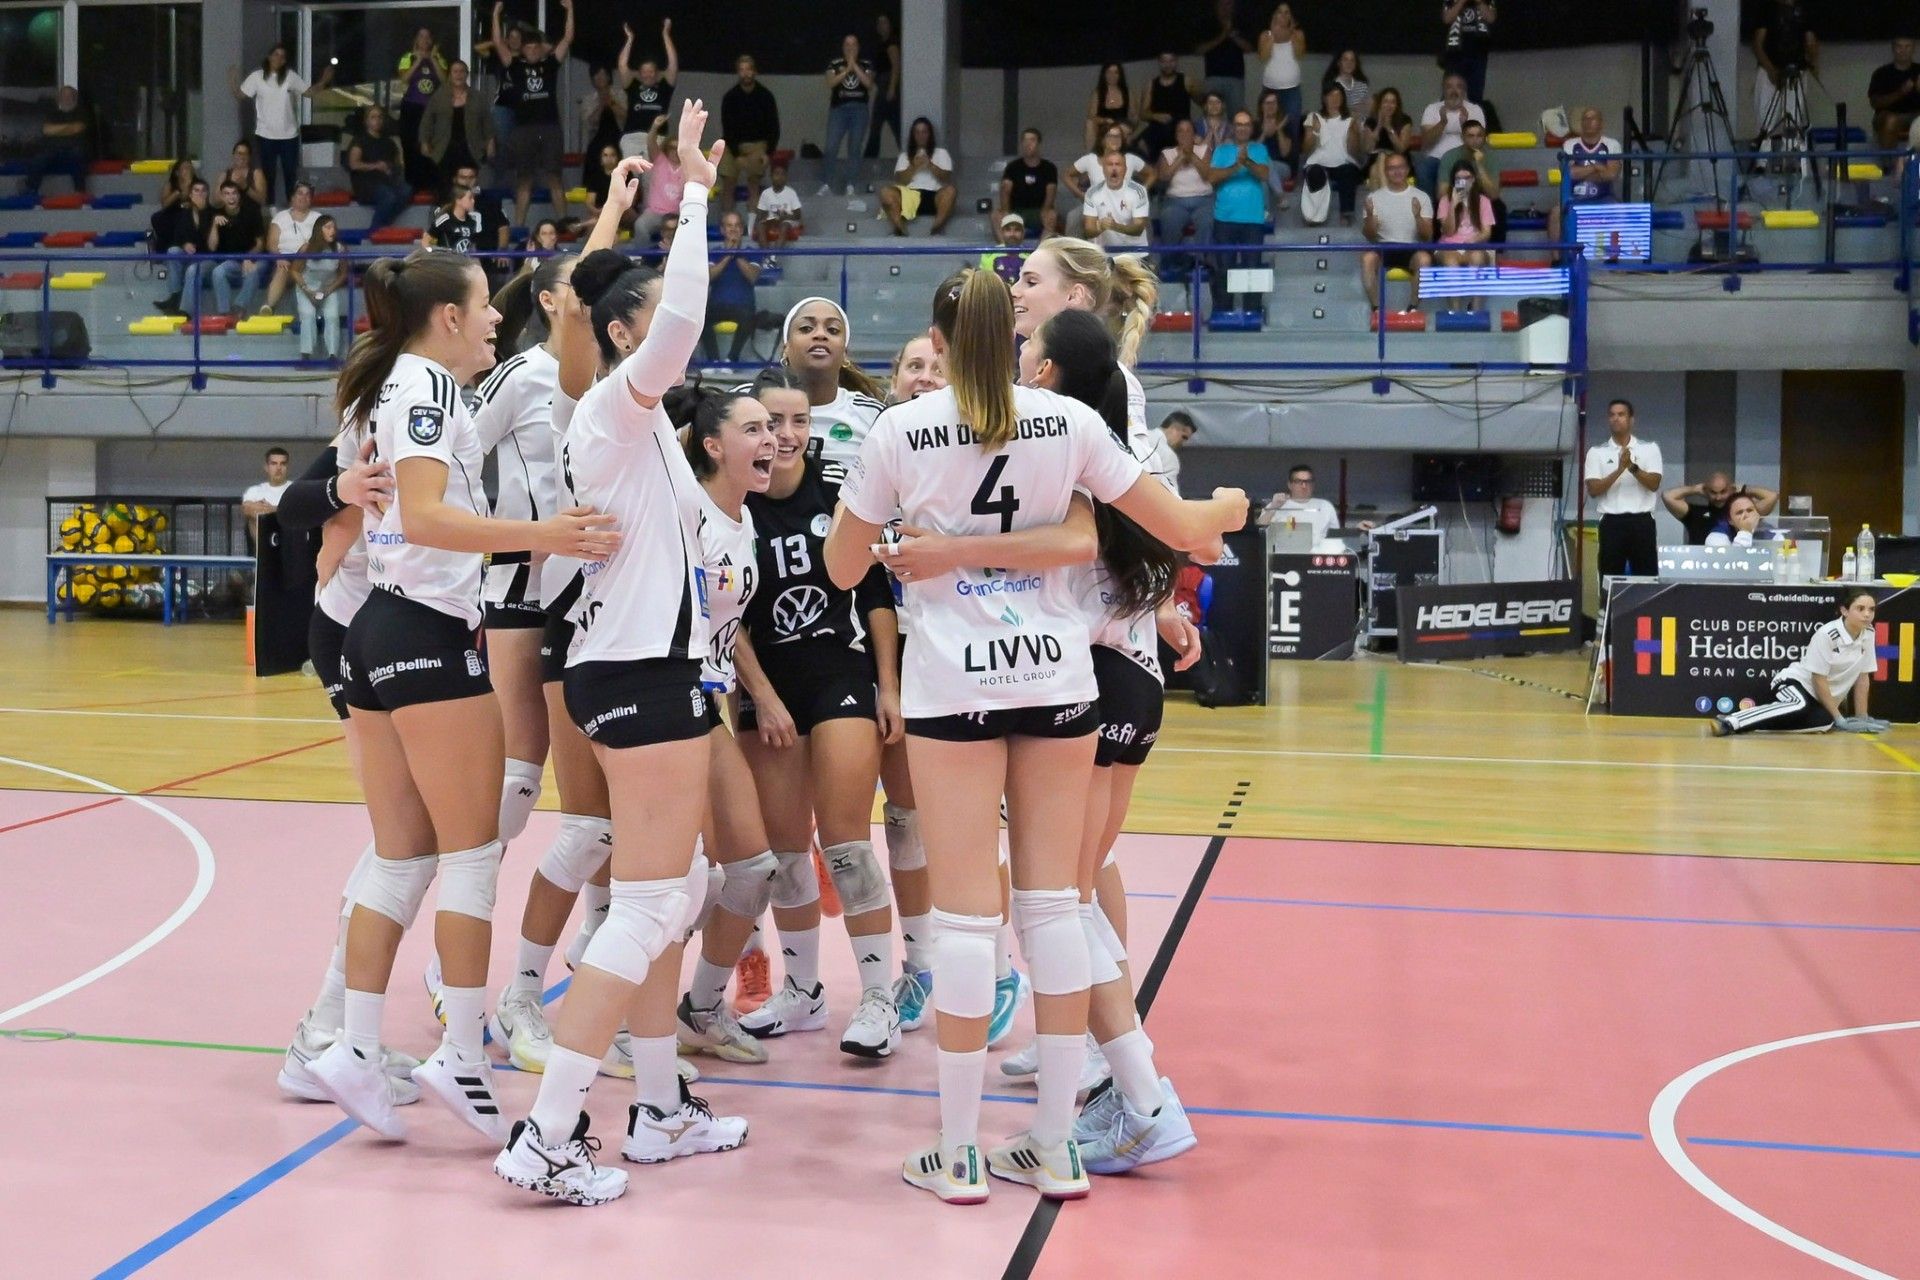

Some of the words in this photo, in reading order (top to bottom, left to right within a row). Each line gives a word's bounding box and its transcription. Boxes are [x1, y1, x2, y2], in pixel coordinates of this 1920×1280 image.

[412, 408, 428, 416] CEV
[906, 425, 950, 451] VAN
[1008, 415, 1068, 441] OSCH
[971, 454, 1020, 534] 4
[770, 533, 812, 579] 13
[1768, 594, 1836, 604] cdheidelberg.es
[1416, 598, 1573, 630] HEIDELBERG
[1690, 619, 1730, 632] CLUB
[964, 633, 1063, 673] LIVVO
[1271, 645, 1297, 654] EGURA
[1688, 635, 1810, 660] Heidelber
[396, 657, 443, 673] Bellini
[1689, 667, 1736, 678] GRAN
[979, 675, 1019, 686] HOTEL
[1023, 669, 1057, 682] GROUP
[597, 703, 638, 725] Bellini
